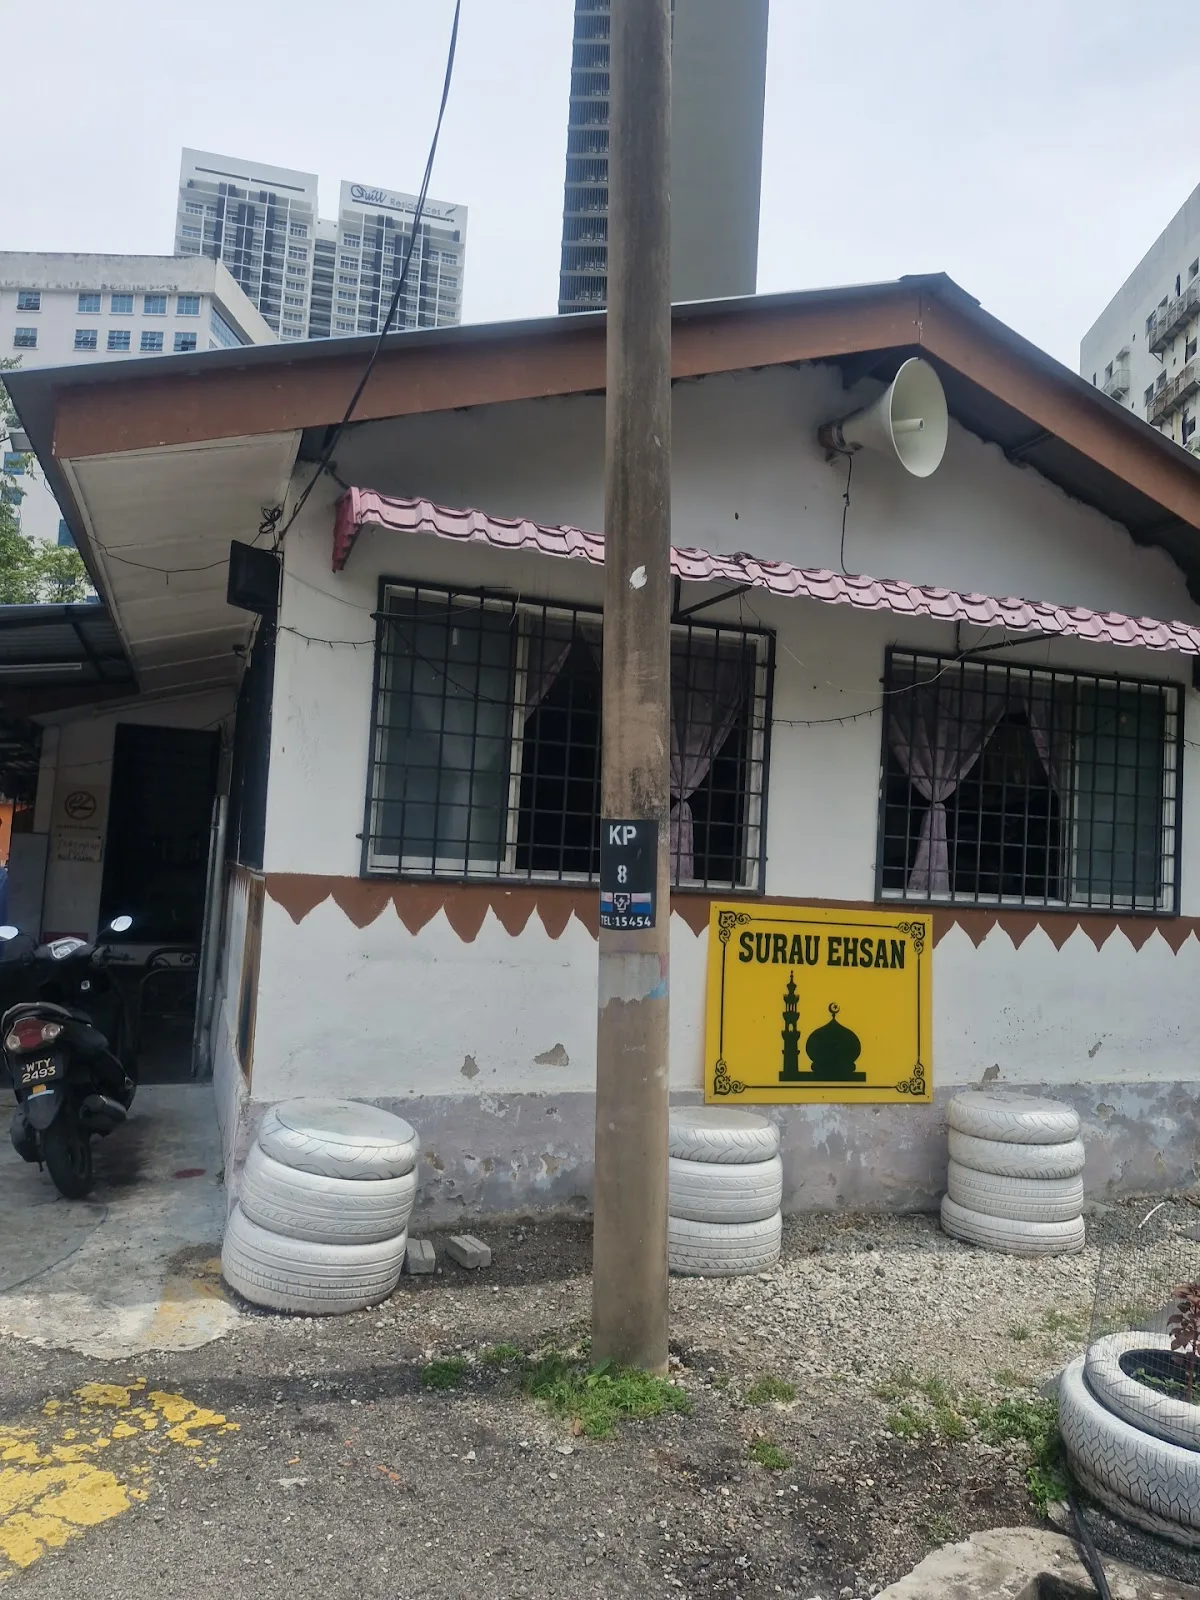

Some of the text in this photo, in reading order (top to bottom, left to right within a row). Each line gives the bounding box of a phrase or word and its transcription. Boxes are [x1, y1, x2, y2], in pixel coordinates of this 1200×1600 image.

[351, 184, 441, 216] Quill Resideces
[609, 825, 637, 845] KP
[617, 864, 627, 883] 8
[738, 931, 906, 969] SURAU EHSAN
[26, 1057, 51, 1072] WTY
[22, 1066, 56, 1083] 2493
